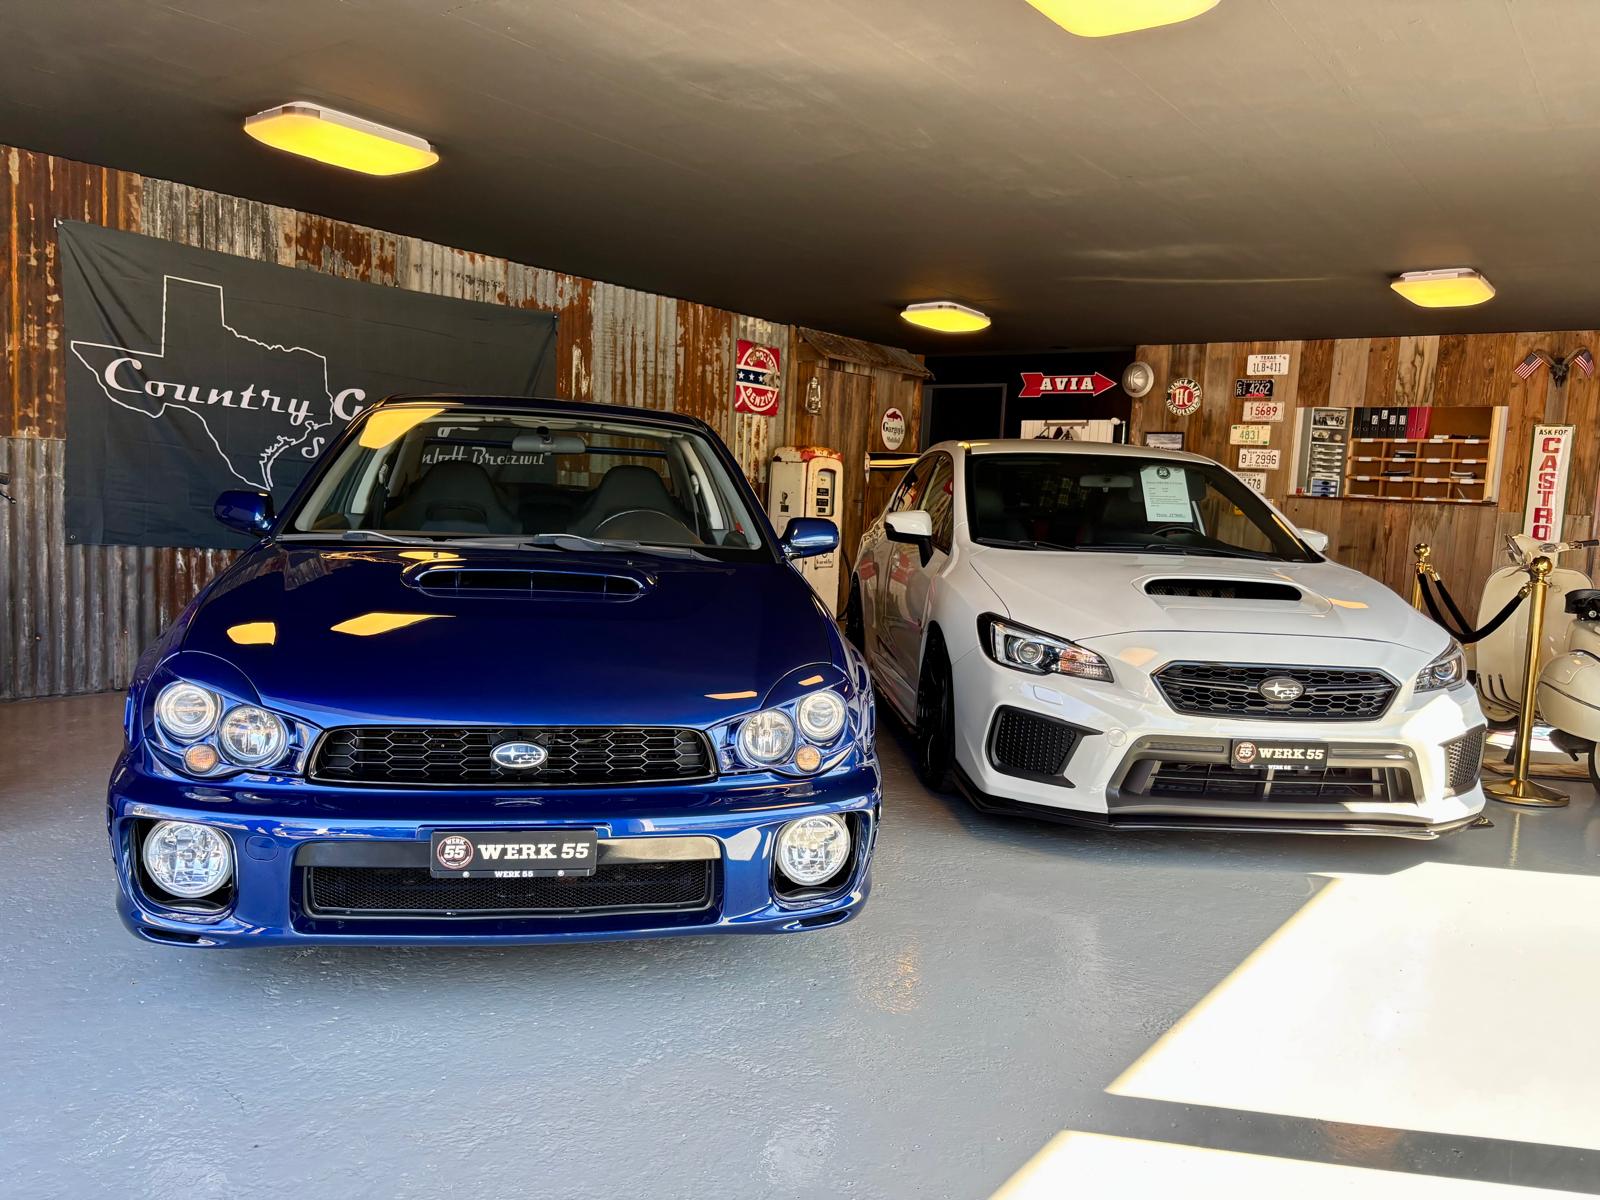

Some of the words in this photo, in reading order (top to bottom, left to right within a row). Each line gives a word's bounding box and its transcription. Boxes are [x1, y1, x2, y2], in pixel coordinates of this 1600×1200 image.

[105, 357, 314, 425] Country
[1040, 377, 1094, 391] AVIA
[1167, 379, 1201, 396] SINCLAIR
[1249, 383, 1271, 394] 4262
[746, 387, 773, 407] BENZIN
[1174, 388, 1194, 406] HC
[1166, 398, 1200, 416] GASOLINE
[1239, 430, 1260, 440] 4831
[1255, 454, 1277, 465] 2996
[1532, 437, 1562, 541] CASTRO
[1258, 747, 1305, 759] WERK
[1306, 749, 1325, 760] 55
[444, 845, 466, 859] 55
[477, 844, 557, 860] WERK
[561, 843, 590, 859] 55
